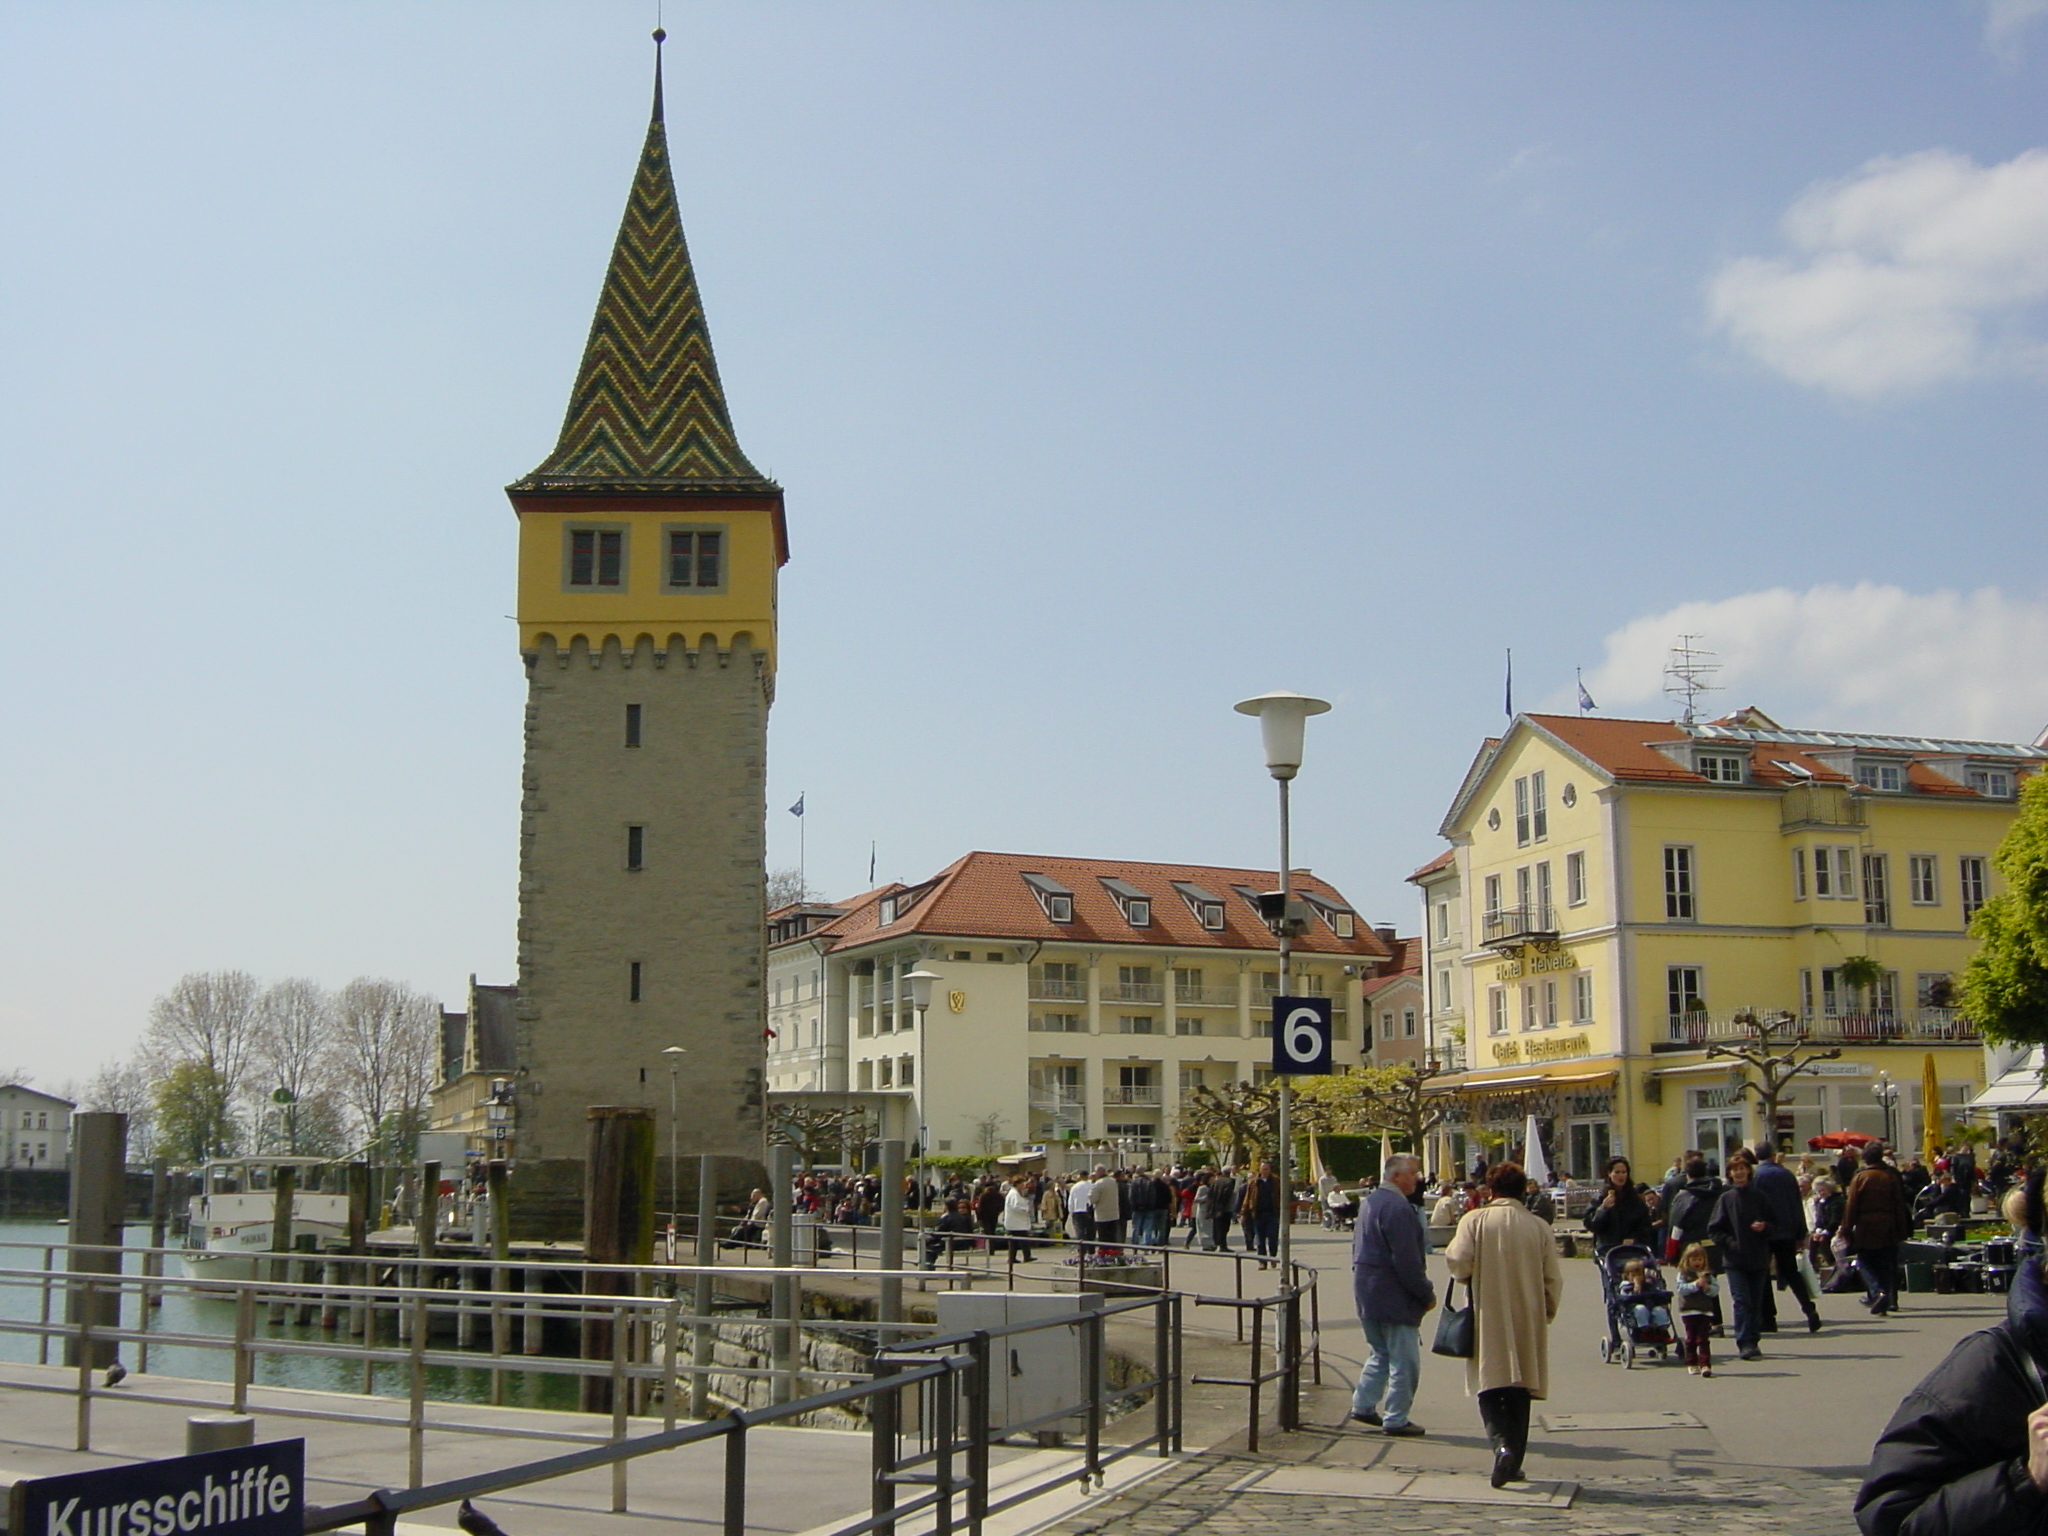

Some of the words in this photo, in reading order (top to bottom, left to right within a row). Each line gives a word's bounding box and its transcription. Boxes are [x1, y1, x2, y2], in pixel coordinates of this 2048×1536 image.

[1496, 961, 1523, 980] Hotel
[1531, 953, 1575, 974] Helvetia
[1284, 1007, 1323, 1063] 6
[1525, 1033, 1590, 1056] Restaurant
[497, 1127, 506, 1139] 5
[47, 1465, 291, 1536] Kursschiffe
